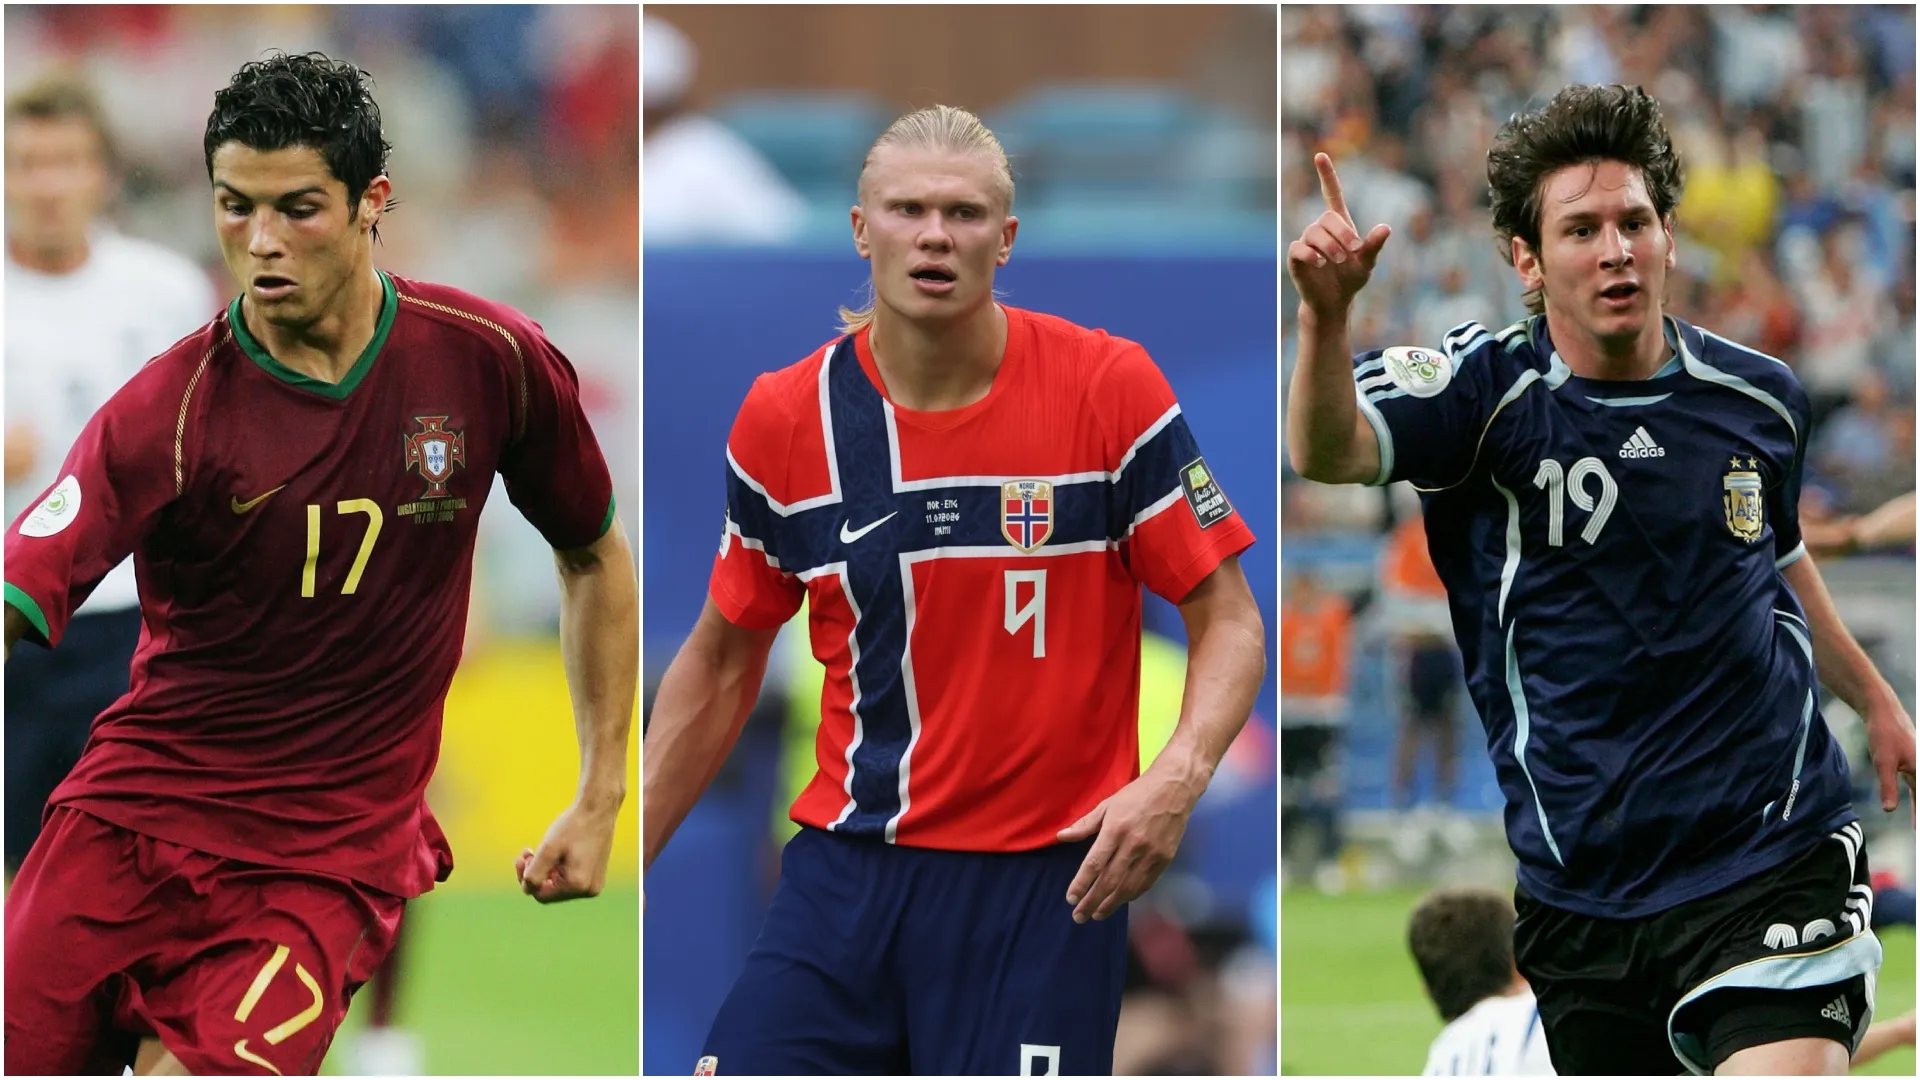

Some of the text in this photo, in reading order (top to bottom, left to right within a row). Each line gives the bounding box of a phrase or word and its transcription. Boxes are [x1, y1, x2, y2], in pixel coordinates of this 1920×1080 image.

[1619, 447, 1665, 458] adidas
[926, 500, 940, 510] NOR
[944, 499, 958, 509] ENG
[1209, 507, 1224, 518] FIFA
[1532, 457, 1618, 546] 19
[302, 498, 383, 597] 17
[1004, 569, 1047, 658] 9
[234, 944, 324, 1045] 17
[1821, 1008, 1851, 1030] adida
